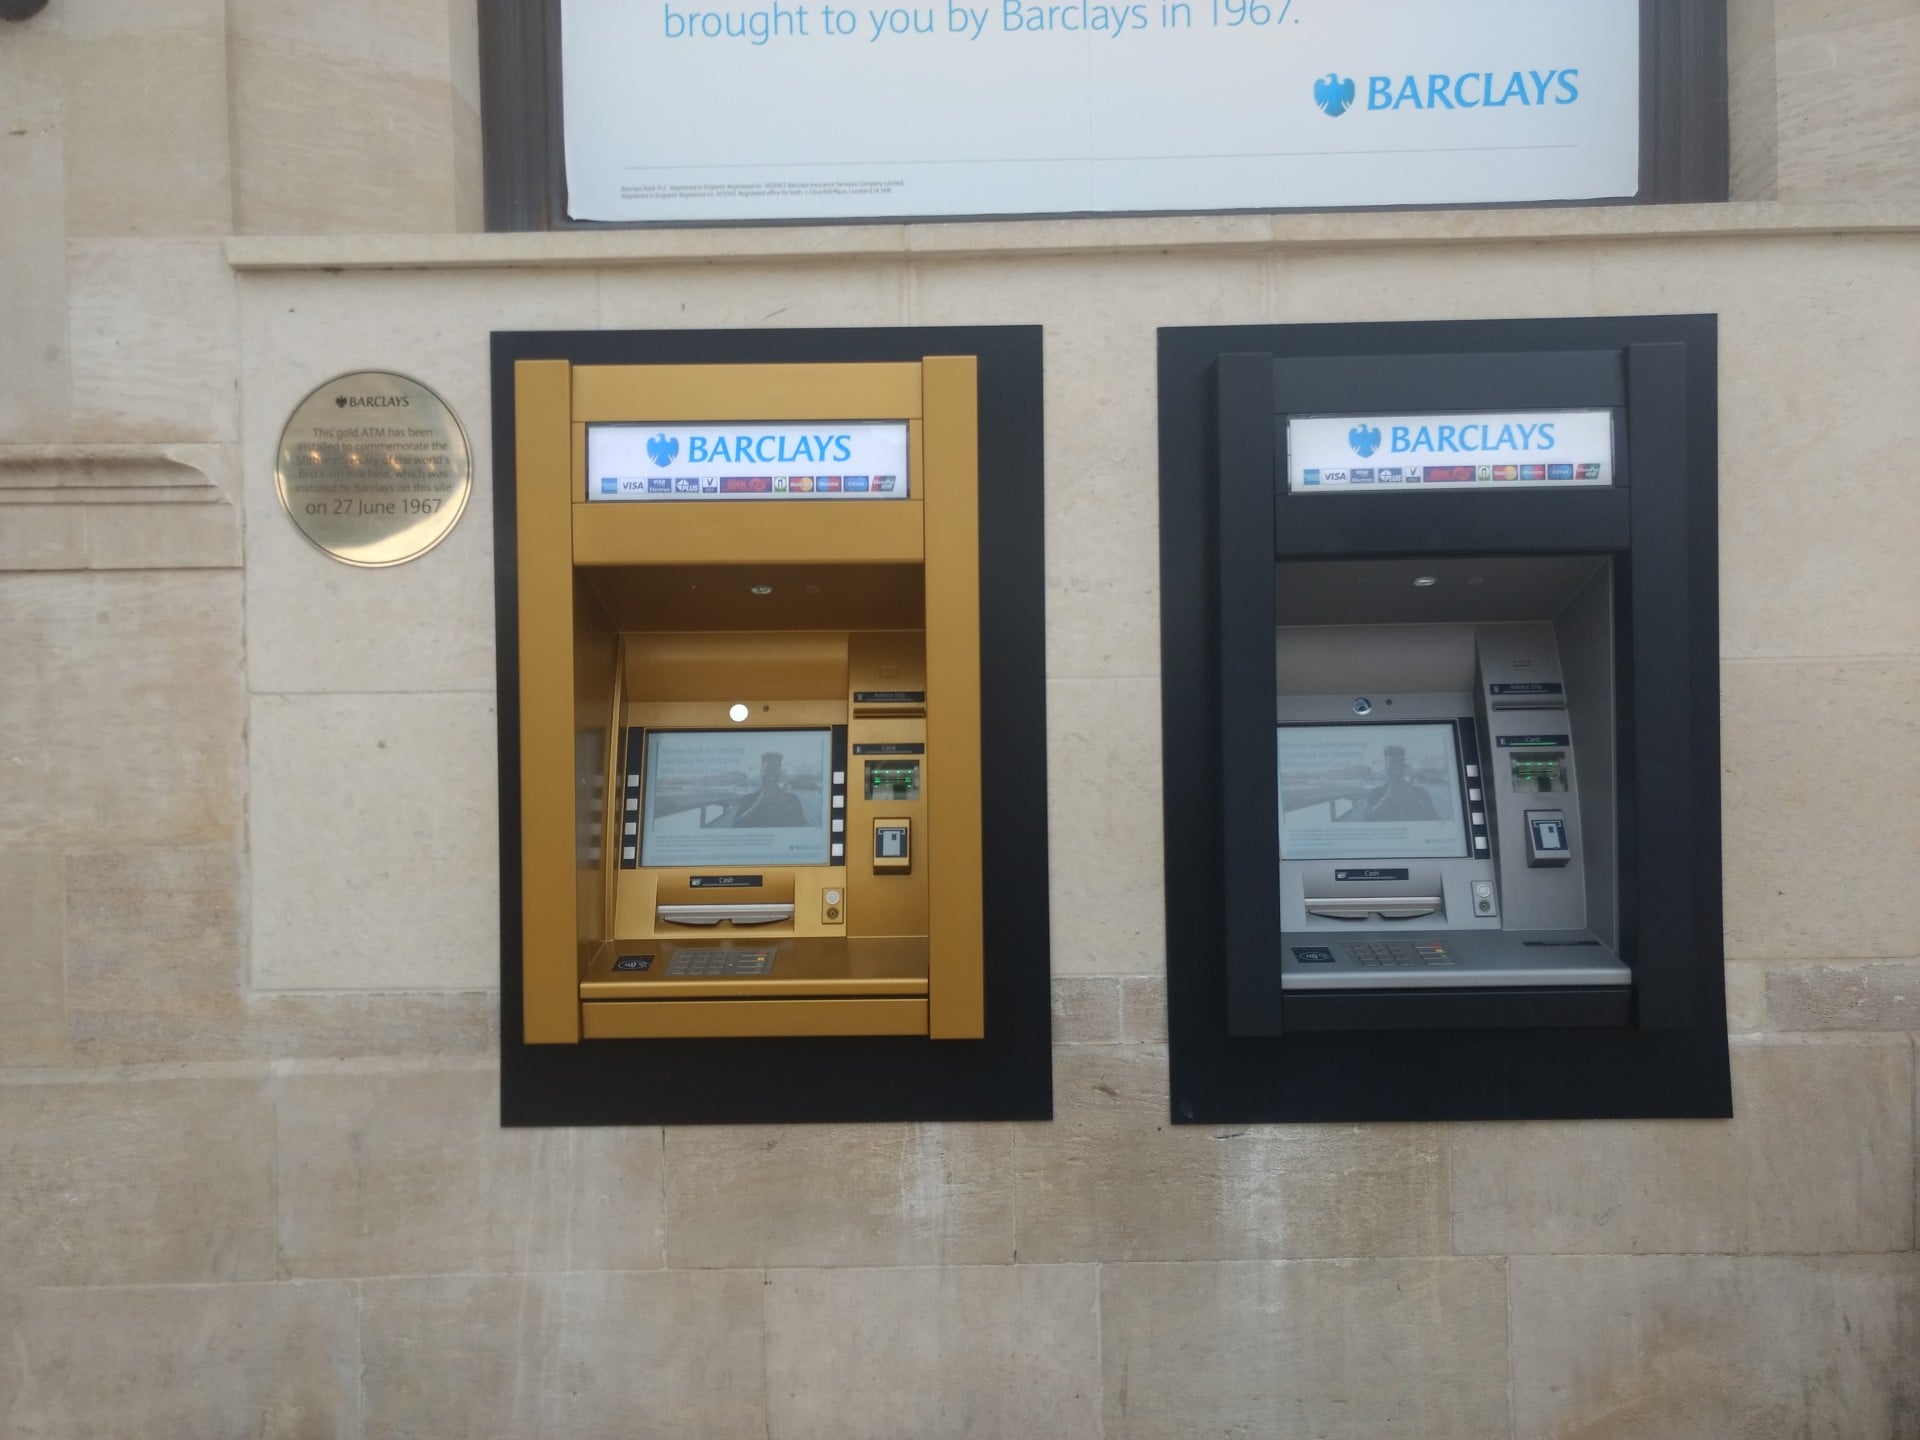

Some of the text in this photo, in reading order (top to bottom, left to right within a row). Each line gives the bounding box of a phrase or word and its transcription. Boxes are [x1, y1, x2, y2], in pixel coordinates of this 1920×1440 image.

[664, 2, 808, 45] brought
[821, 5, 856, 36] to
[869, 8, 934, 42] you
[948, 0, 989, 41] by
[1003, 0, 1148, 38] Barclays
[1161, 0, 1191, 28] in
[1367, 69, 1579, 111] BARCLAYS
[349, 396, 410, 408] BARCLAYS
[312, 427, 433, 441] This gold ATM has been
[1390, 423, 1555, 453] BARCLAYS
[431, 441, 448, 450] the
[688, 435, 851, 463] BARCLAYS
[706, 478, 714, 486] V
[1324, 472, 1346, 480] VISA
[622, 481, 644, 490] VISA
[305, 499, 442, 515] on 27 June 1967
